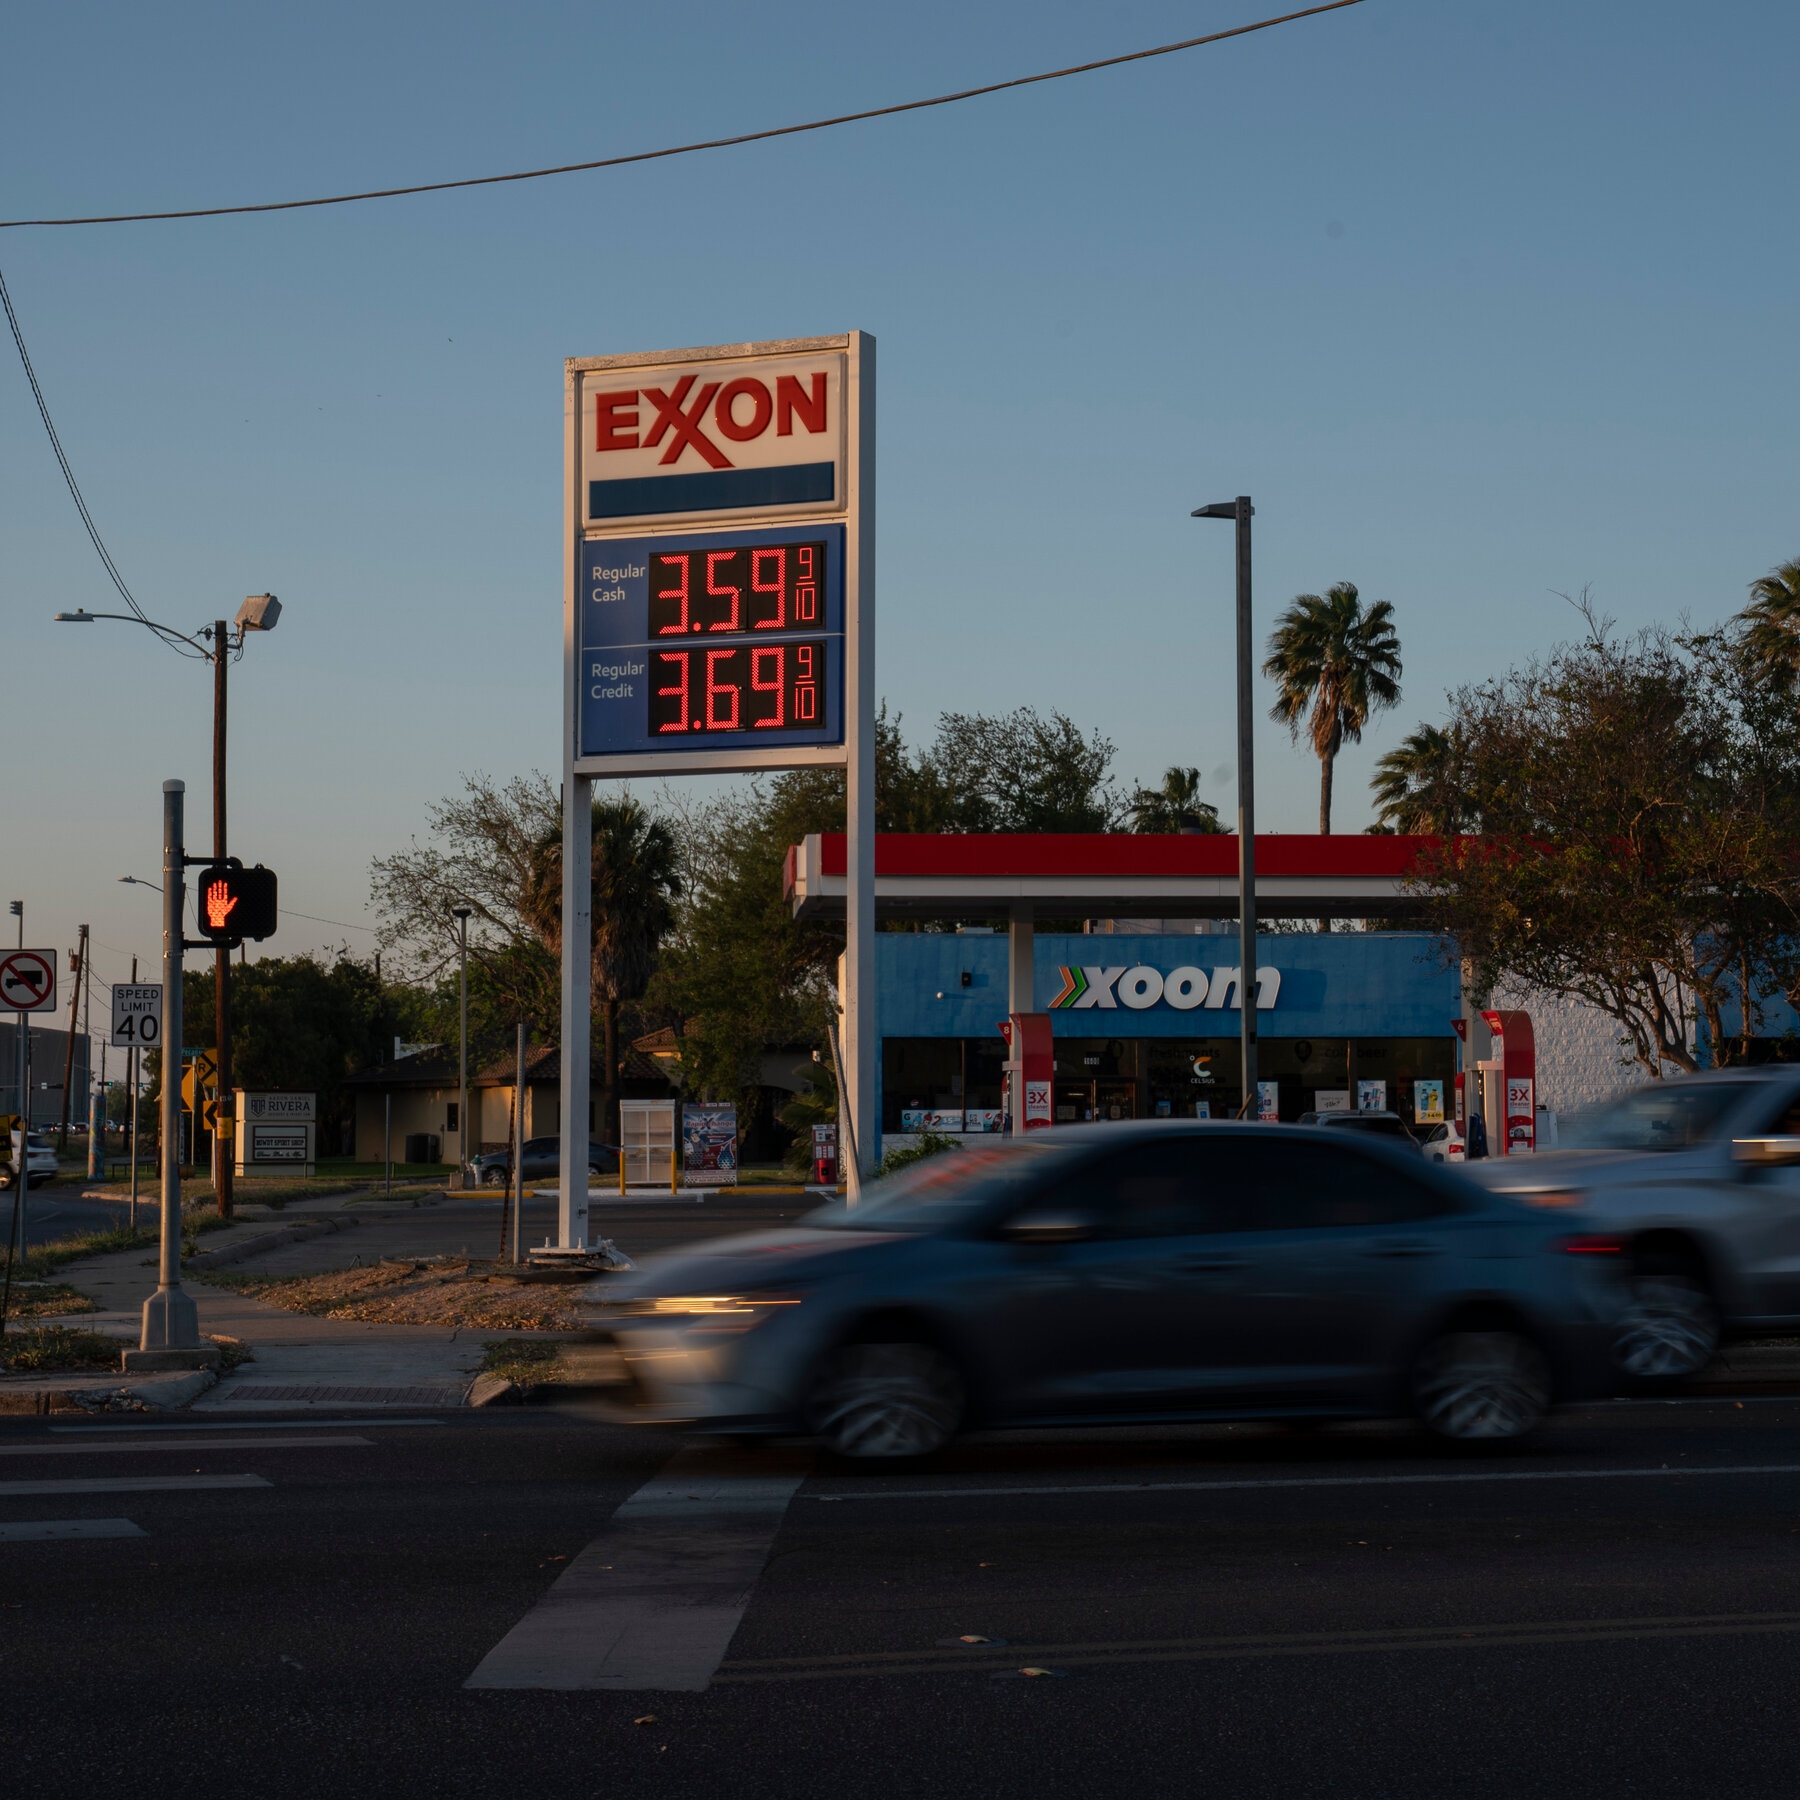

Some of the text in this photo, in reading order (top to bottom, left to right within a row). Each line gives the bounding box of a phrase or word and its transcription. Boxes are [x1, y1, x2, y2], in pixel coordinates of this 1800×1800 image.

[595, 372, 828, 469] EXXON
[592, 564, 646, 583] Regular
[592, 586, 626, 602] Cash
[658, 549, 786, 635] 3.59
[591, 661, 645, 680] Regular
[591, 683, 634, 699] Credit
[658, 647, 785, 732] 3.69
[117, 989, 159, 999] SPEED
[1070, 965, 1282, 1010] xoom
[121, 1002, 154, 1012] LIMIT
[116, 1014, 158, 1041] 40
[1003, 1026, 1010, 1034] 8
[1457, 1023, 1464, 1031] 6
[198, 1063, 206, 1072] R
[1028, 1091, 1048, 1104] 3X
[1509, 1088, 1529, 1101] 3X
[268, 1101, 311, 1111] RIVERA
